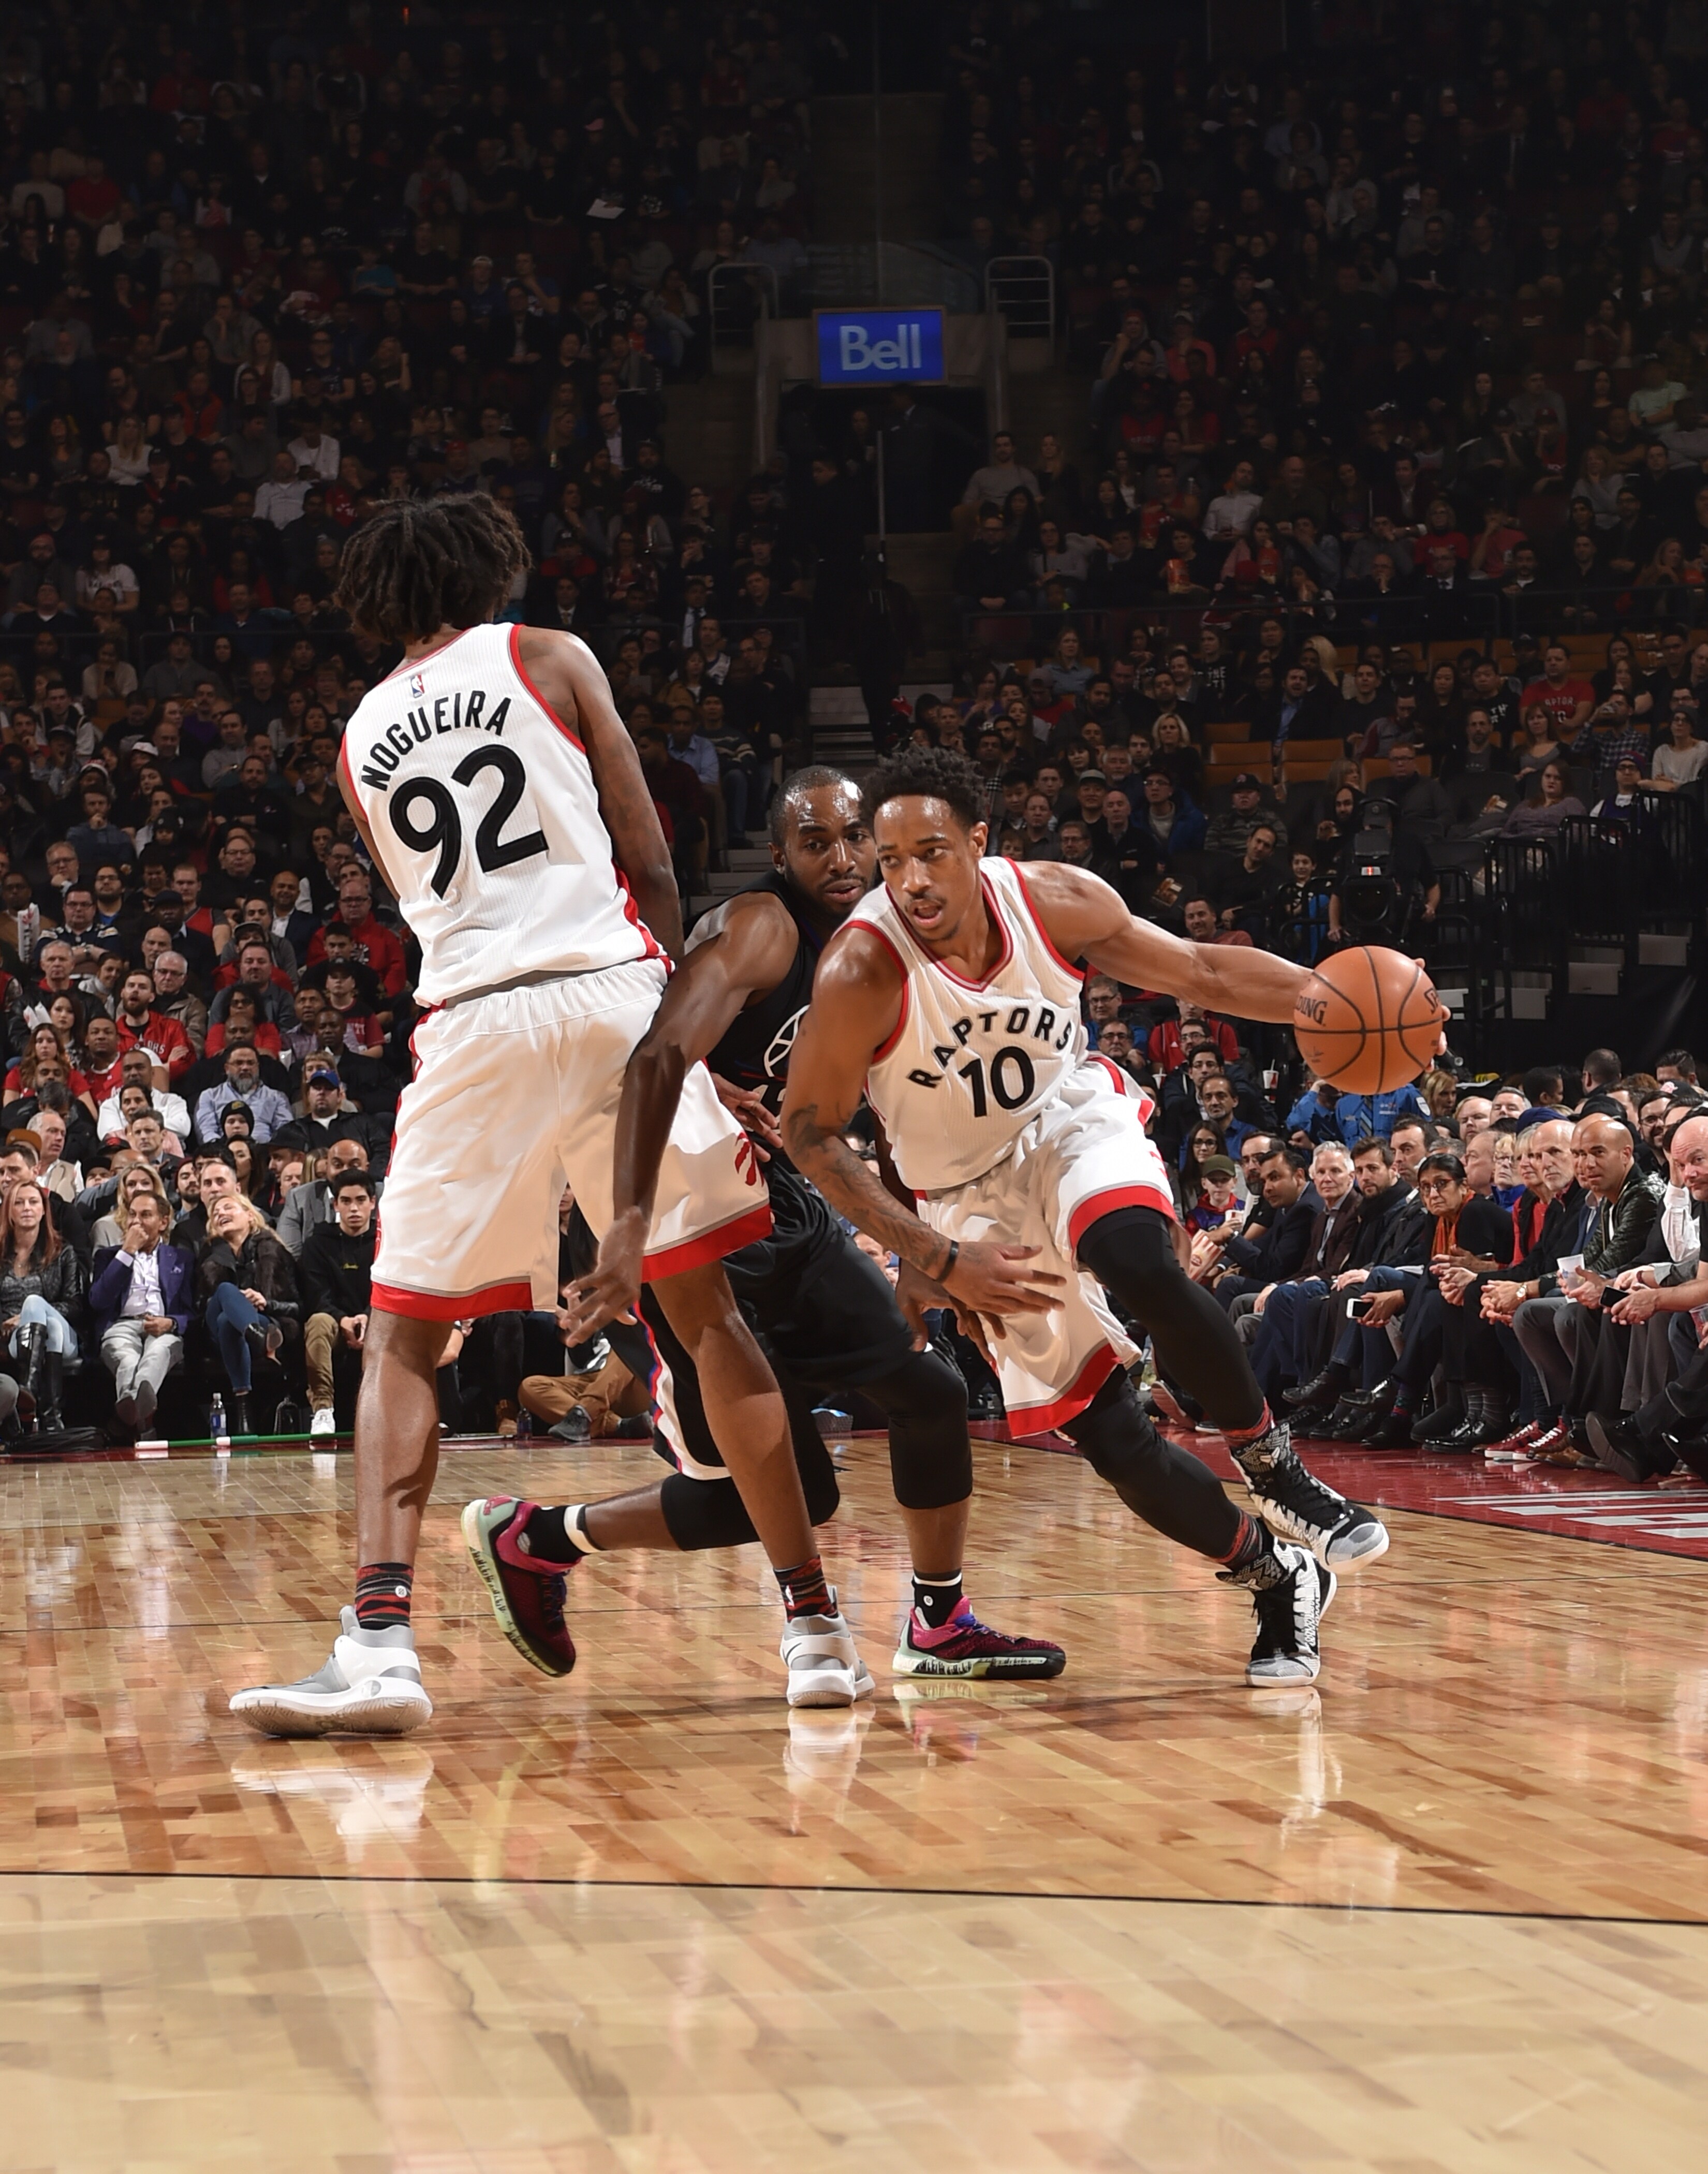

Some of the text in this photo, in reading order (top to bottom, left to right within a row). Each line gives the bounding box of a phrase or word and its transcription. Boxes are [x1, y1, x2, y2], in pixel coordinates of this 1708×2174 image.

[840, 324, 921, 371] Bell
[361, 691, 511, 791] NOGUEIRA
[389, 744, 549, 900] 92
[908, 1007, 1072, 1089] RAPTORS
[958, 1046, 1035, 1118] 10
